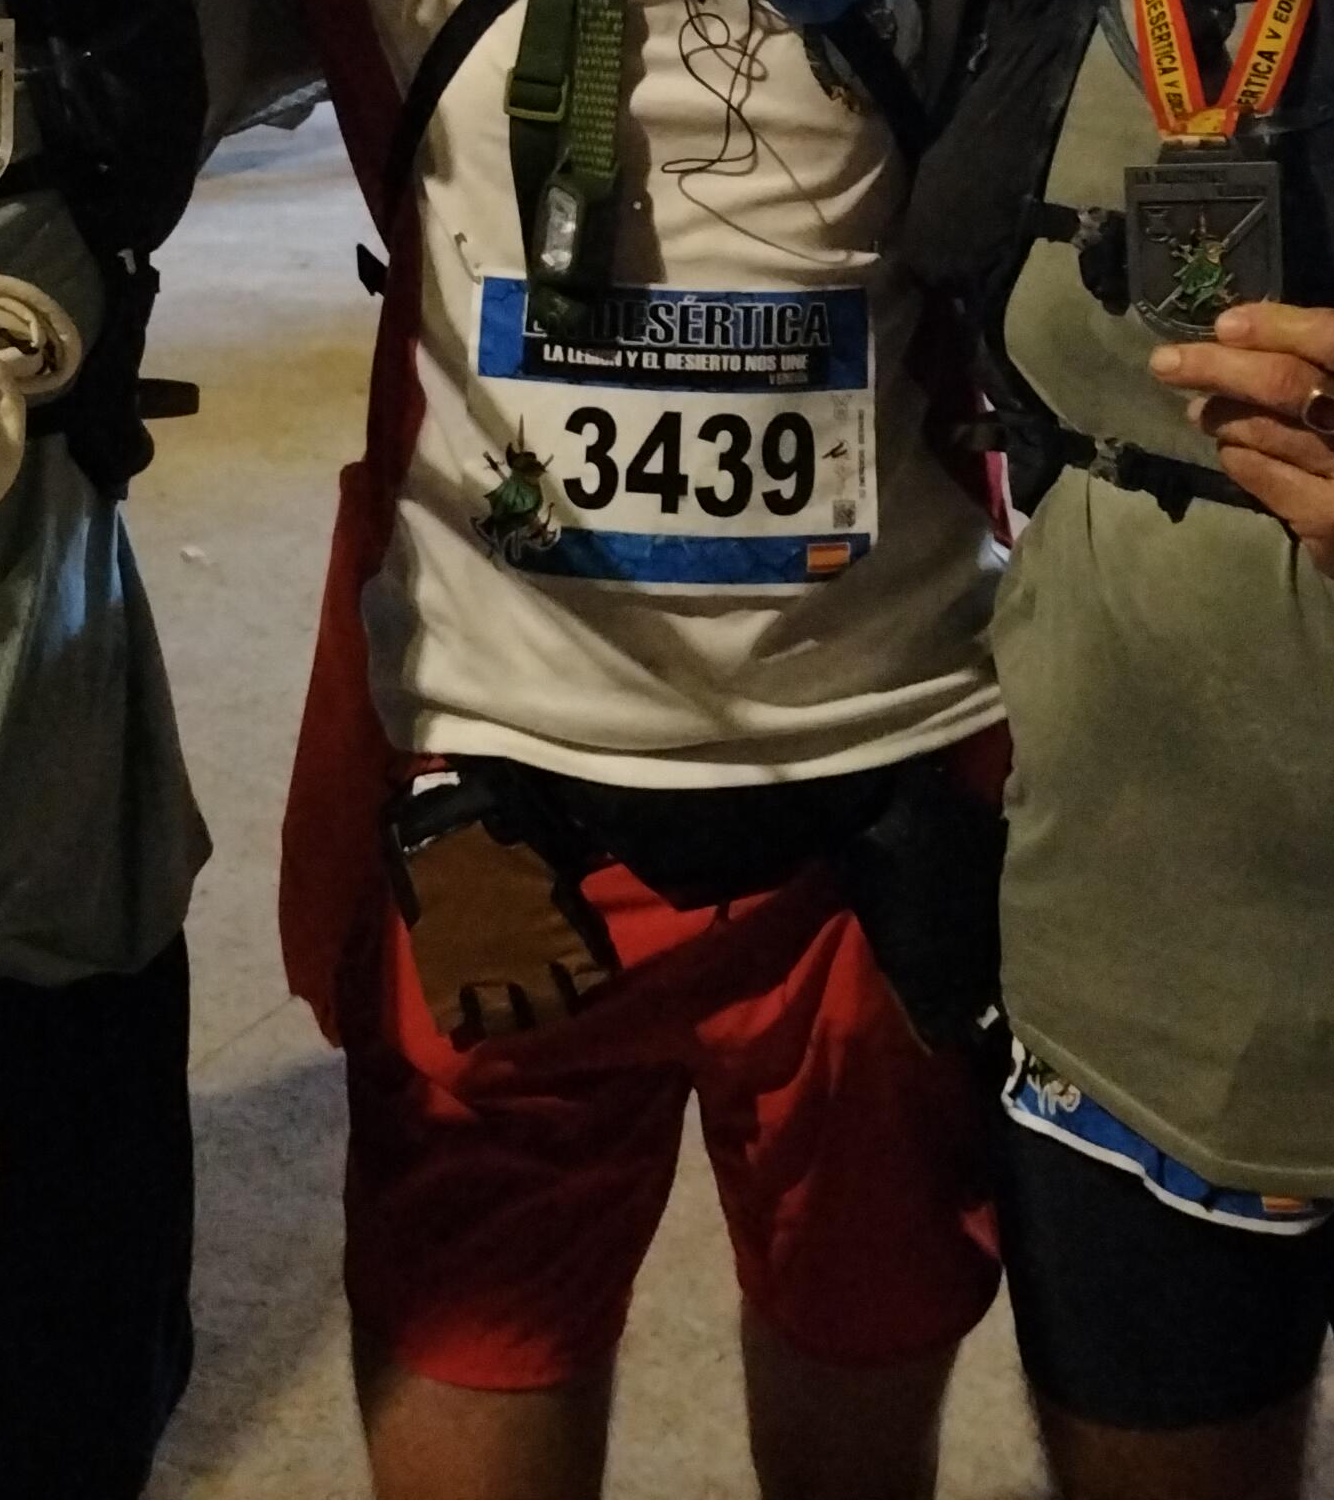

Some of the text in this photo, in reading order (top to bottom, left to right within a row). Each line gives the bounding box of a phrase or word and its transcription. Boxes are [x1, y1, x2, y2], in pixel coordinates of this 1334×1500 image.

[542, 343, 565, 364] LA
[626, 350, 640, 368] Y
[642, 352, 661, 371] EL
[664, 352, 742, 373] DESIERTO
[744, 355, 778, 373] NOS
[780, 354, 809, 372] UNE
[562, 406, 816, 518] 3439
